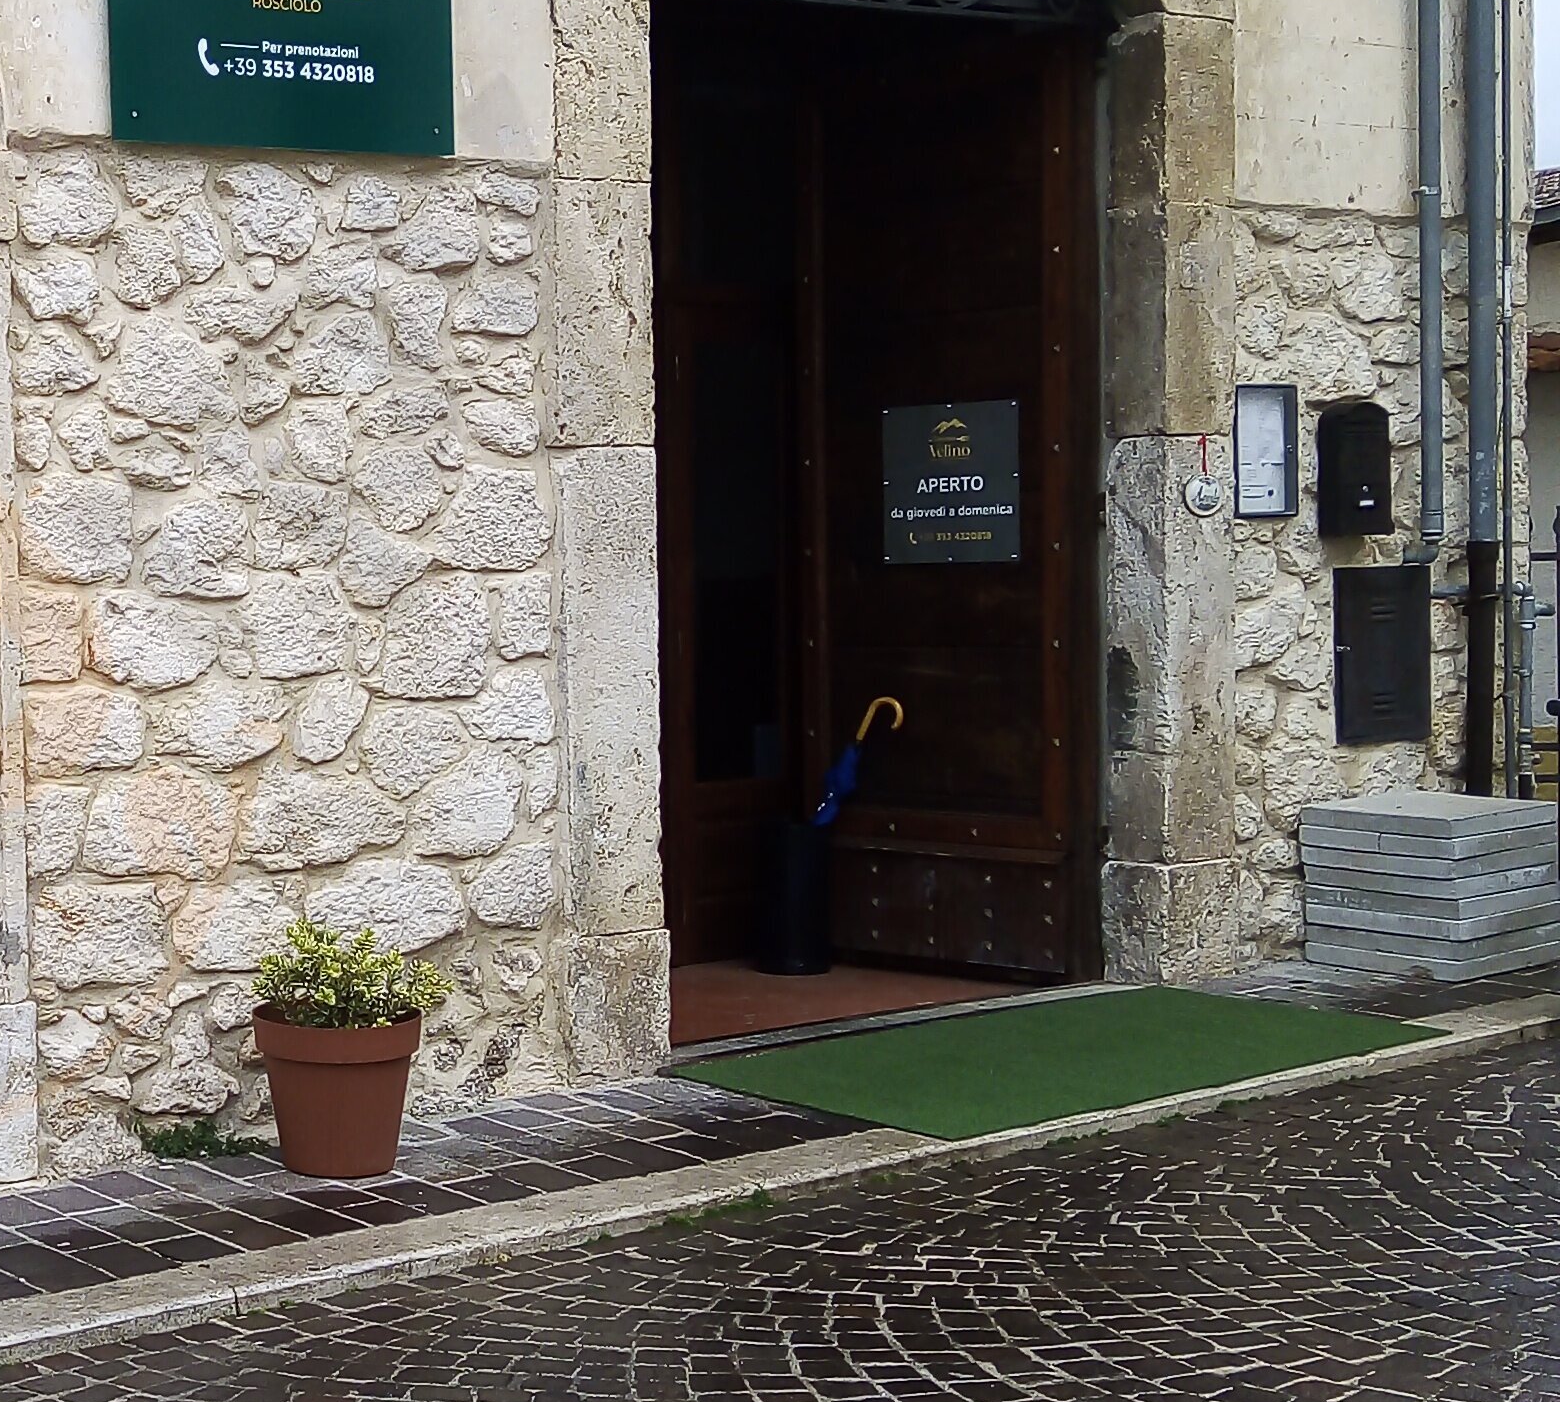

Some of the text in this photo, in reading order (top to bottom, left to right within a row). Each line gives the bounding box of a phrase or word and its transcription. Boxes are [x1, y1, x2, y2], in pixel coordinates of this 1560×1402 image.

[262, 41, 359, 59] Per prenotazioni
[224, 58, 375, 83] +39 353 4320818
[916, 475, 984, 494] APERTO
[891, 507, 904, 519] da
[948, 508, 955, 517] a
[958, 503, 1013, 516] domenica
